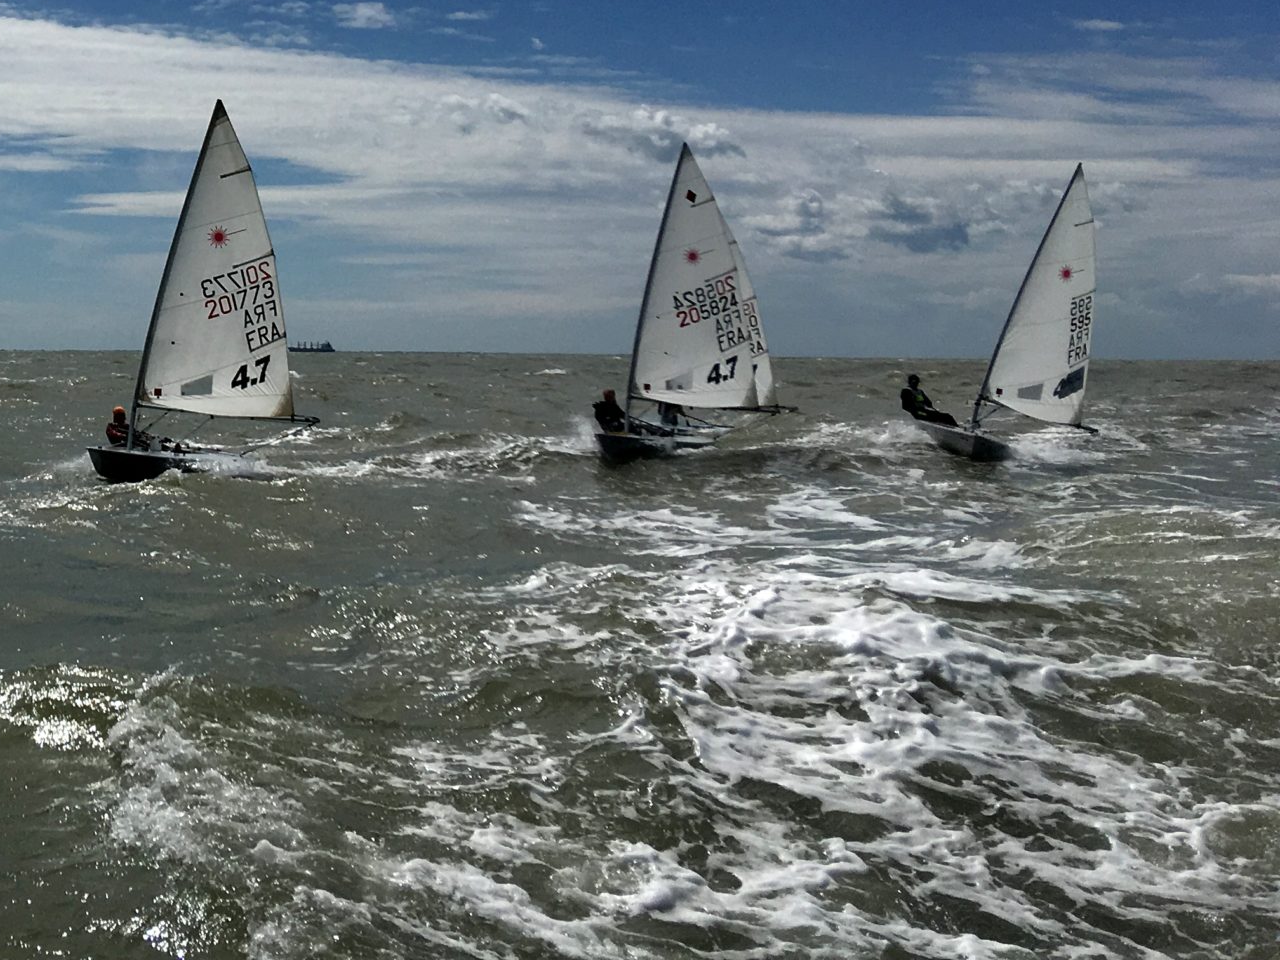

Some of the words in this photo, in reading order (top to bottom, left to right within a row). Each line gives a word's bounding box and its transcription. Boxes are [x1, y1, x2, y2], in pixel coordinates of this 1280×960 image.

[205, 280, 274, 319] 201773
[676, 292, 738, 328] 205824
[245, 322, 281, 352] FRA
[1070, 312, 1091, 332] 595
[717, 327, 746, 352] FRA
[1068, 343, 1087, 365] FRA
[231, 355, 271, 390] 4.7
[707, 355, 738, 385] 4.7
